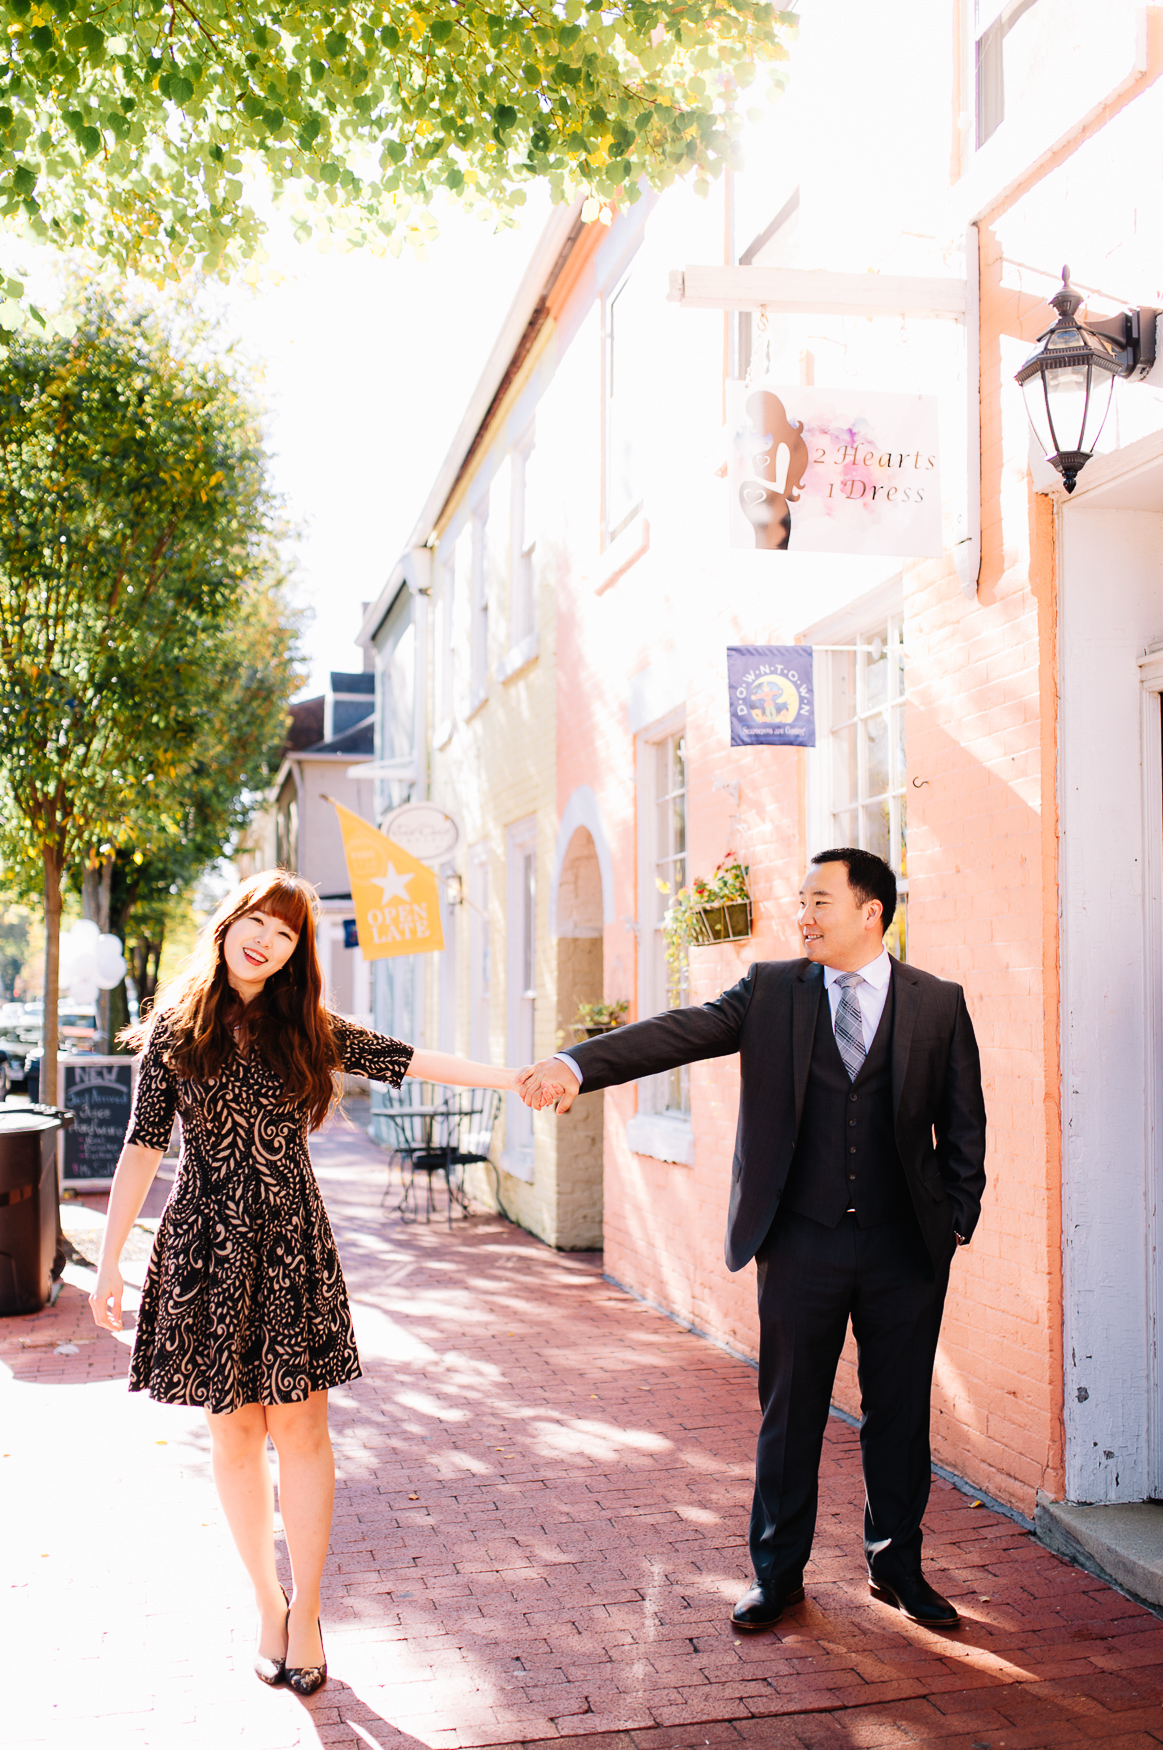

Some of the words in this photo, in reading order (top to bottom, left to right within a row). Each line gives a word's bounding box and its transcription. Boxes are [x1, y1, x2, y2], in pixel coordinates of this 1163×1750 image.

[813, 448, 826, 464] 2
[834, 442, 936, 471] Hearts
[827, 483, 835, 499] 1
[844, 479, 925, 504] Dress
[367, 902, 428, 927] OPEN
[371, 920, 431, 944] LATE
[74, 1066, 119, 1084] NEW
